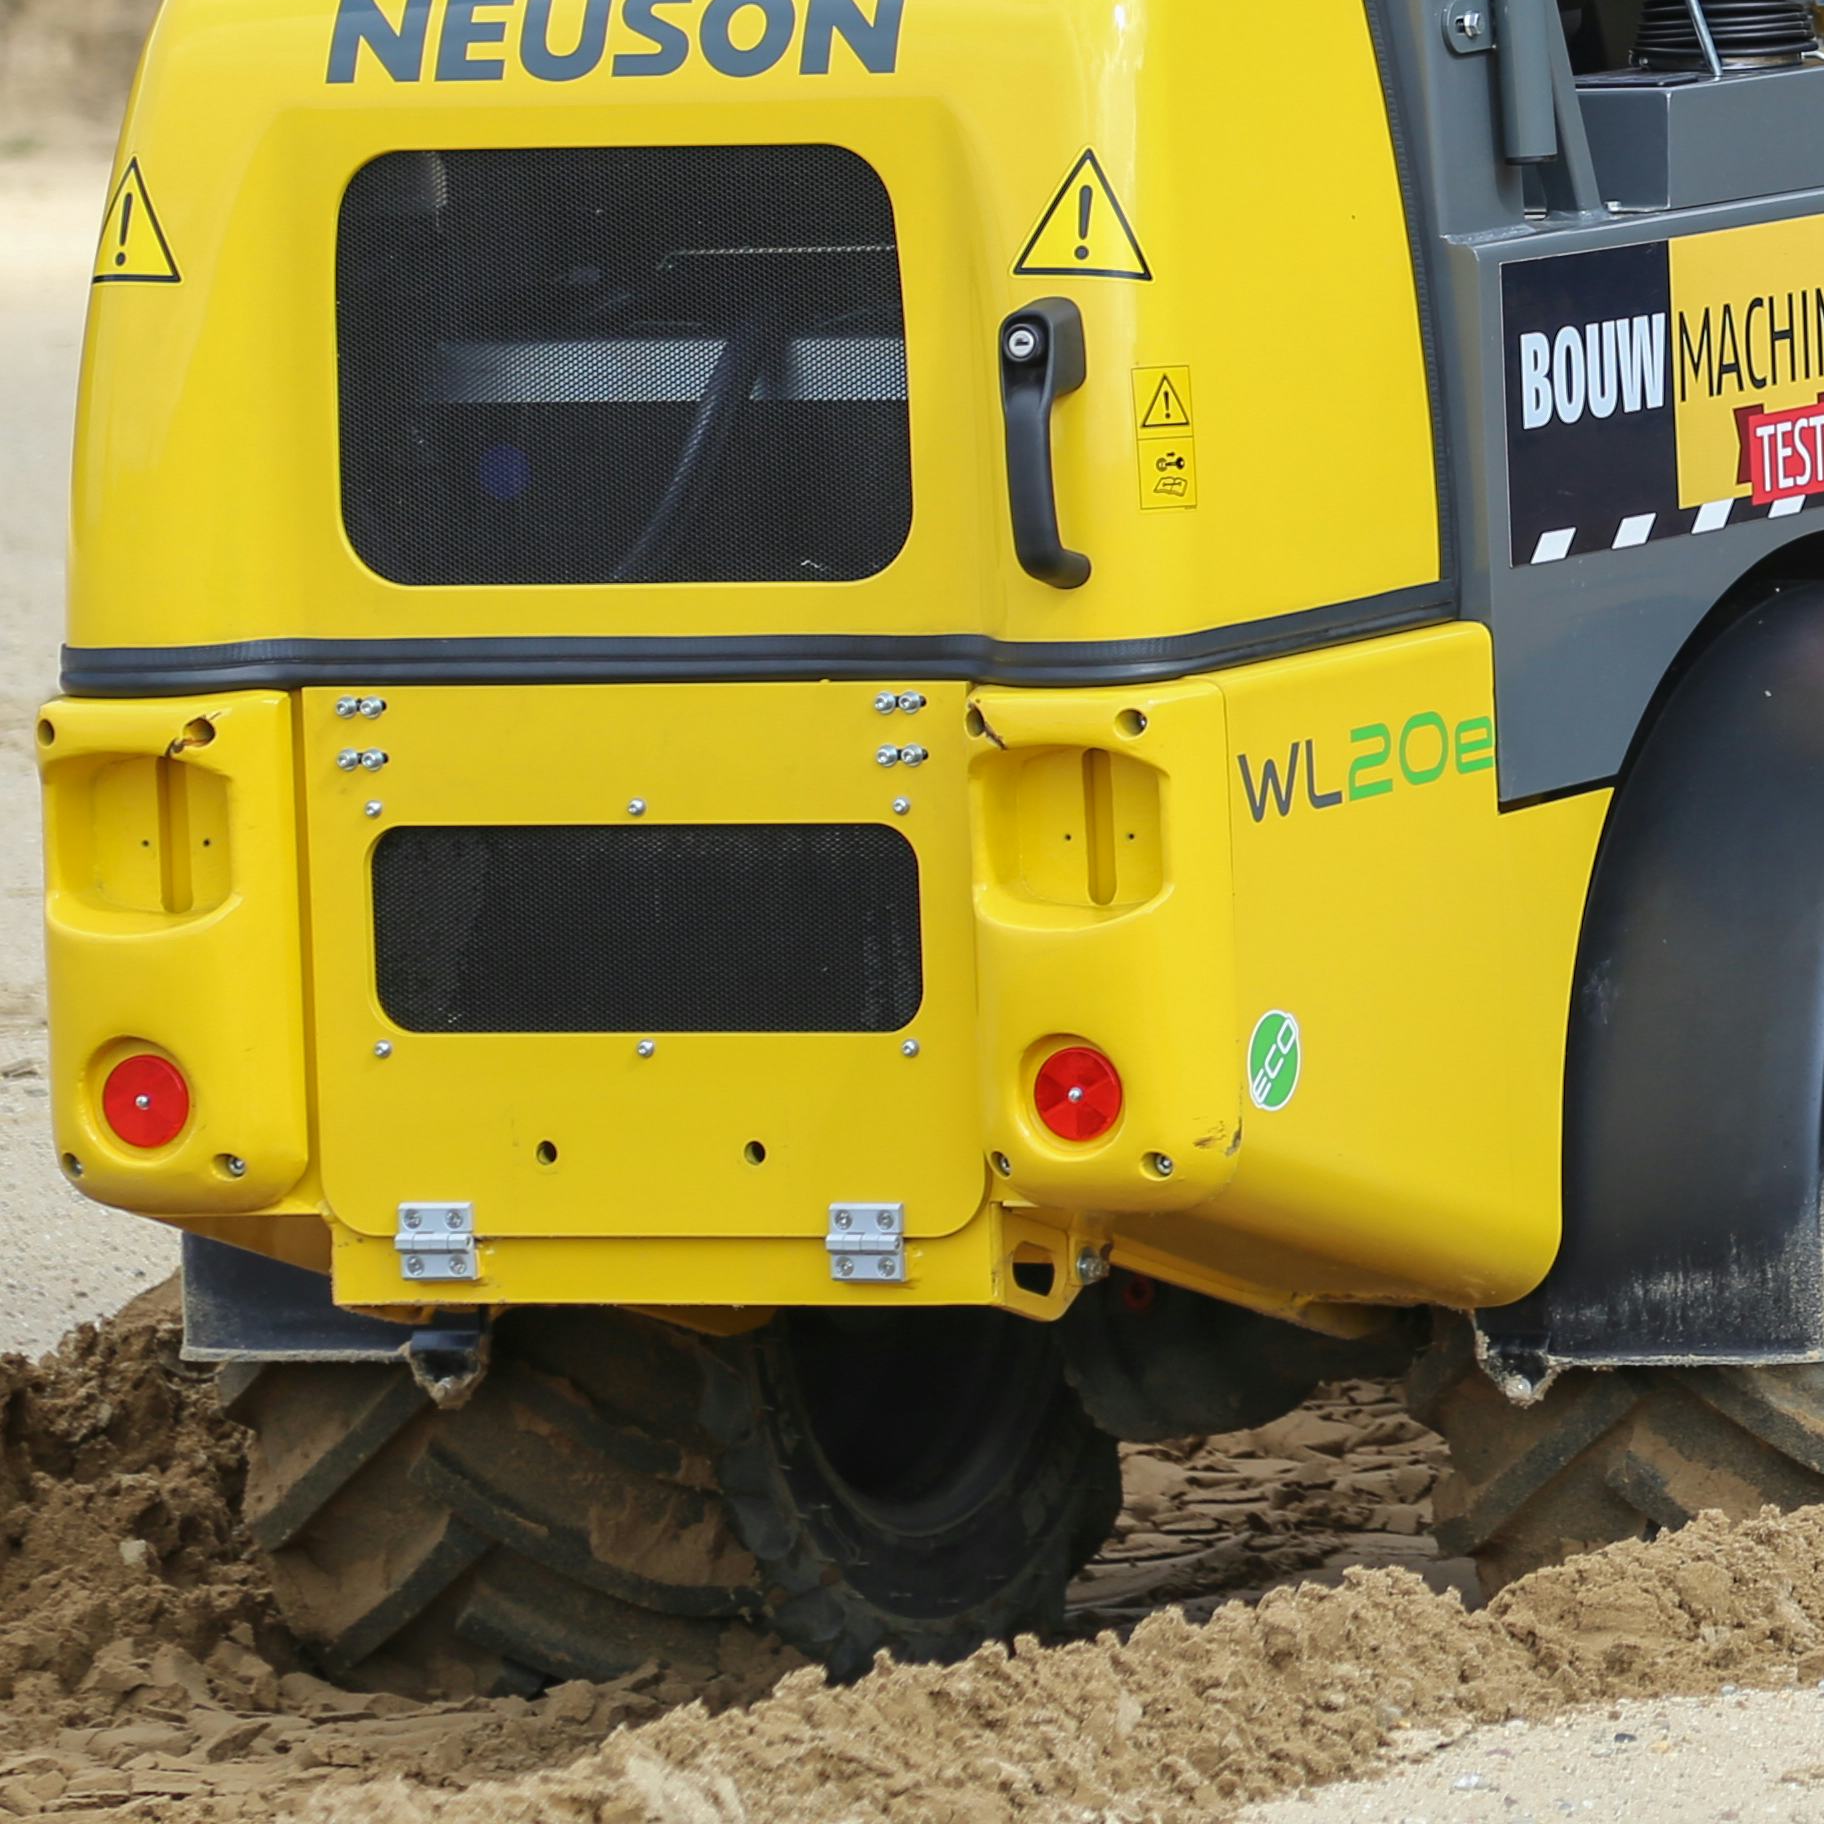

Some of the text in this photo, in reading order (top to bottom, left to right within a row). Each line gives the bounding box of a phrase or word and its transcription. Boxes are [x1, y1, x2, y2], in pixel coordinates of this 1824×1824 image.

[1519, 312, 1668, 431] BOUW
[1236, 710, 1495, 824] WL20e
[1252, 1018, 1297, 1105] ECO
